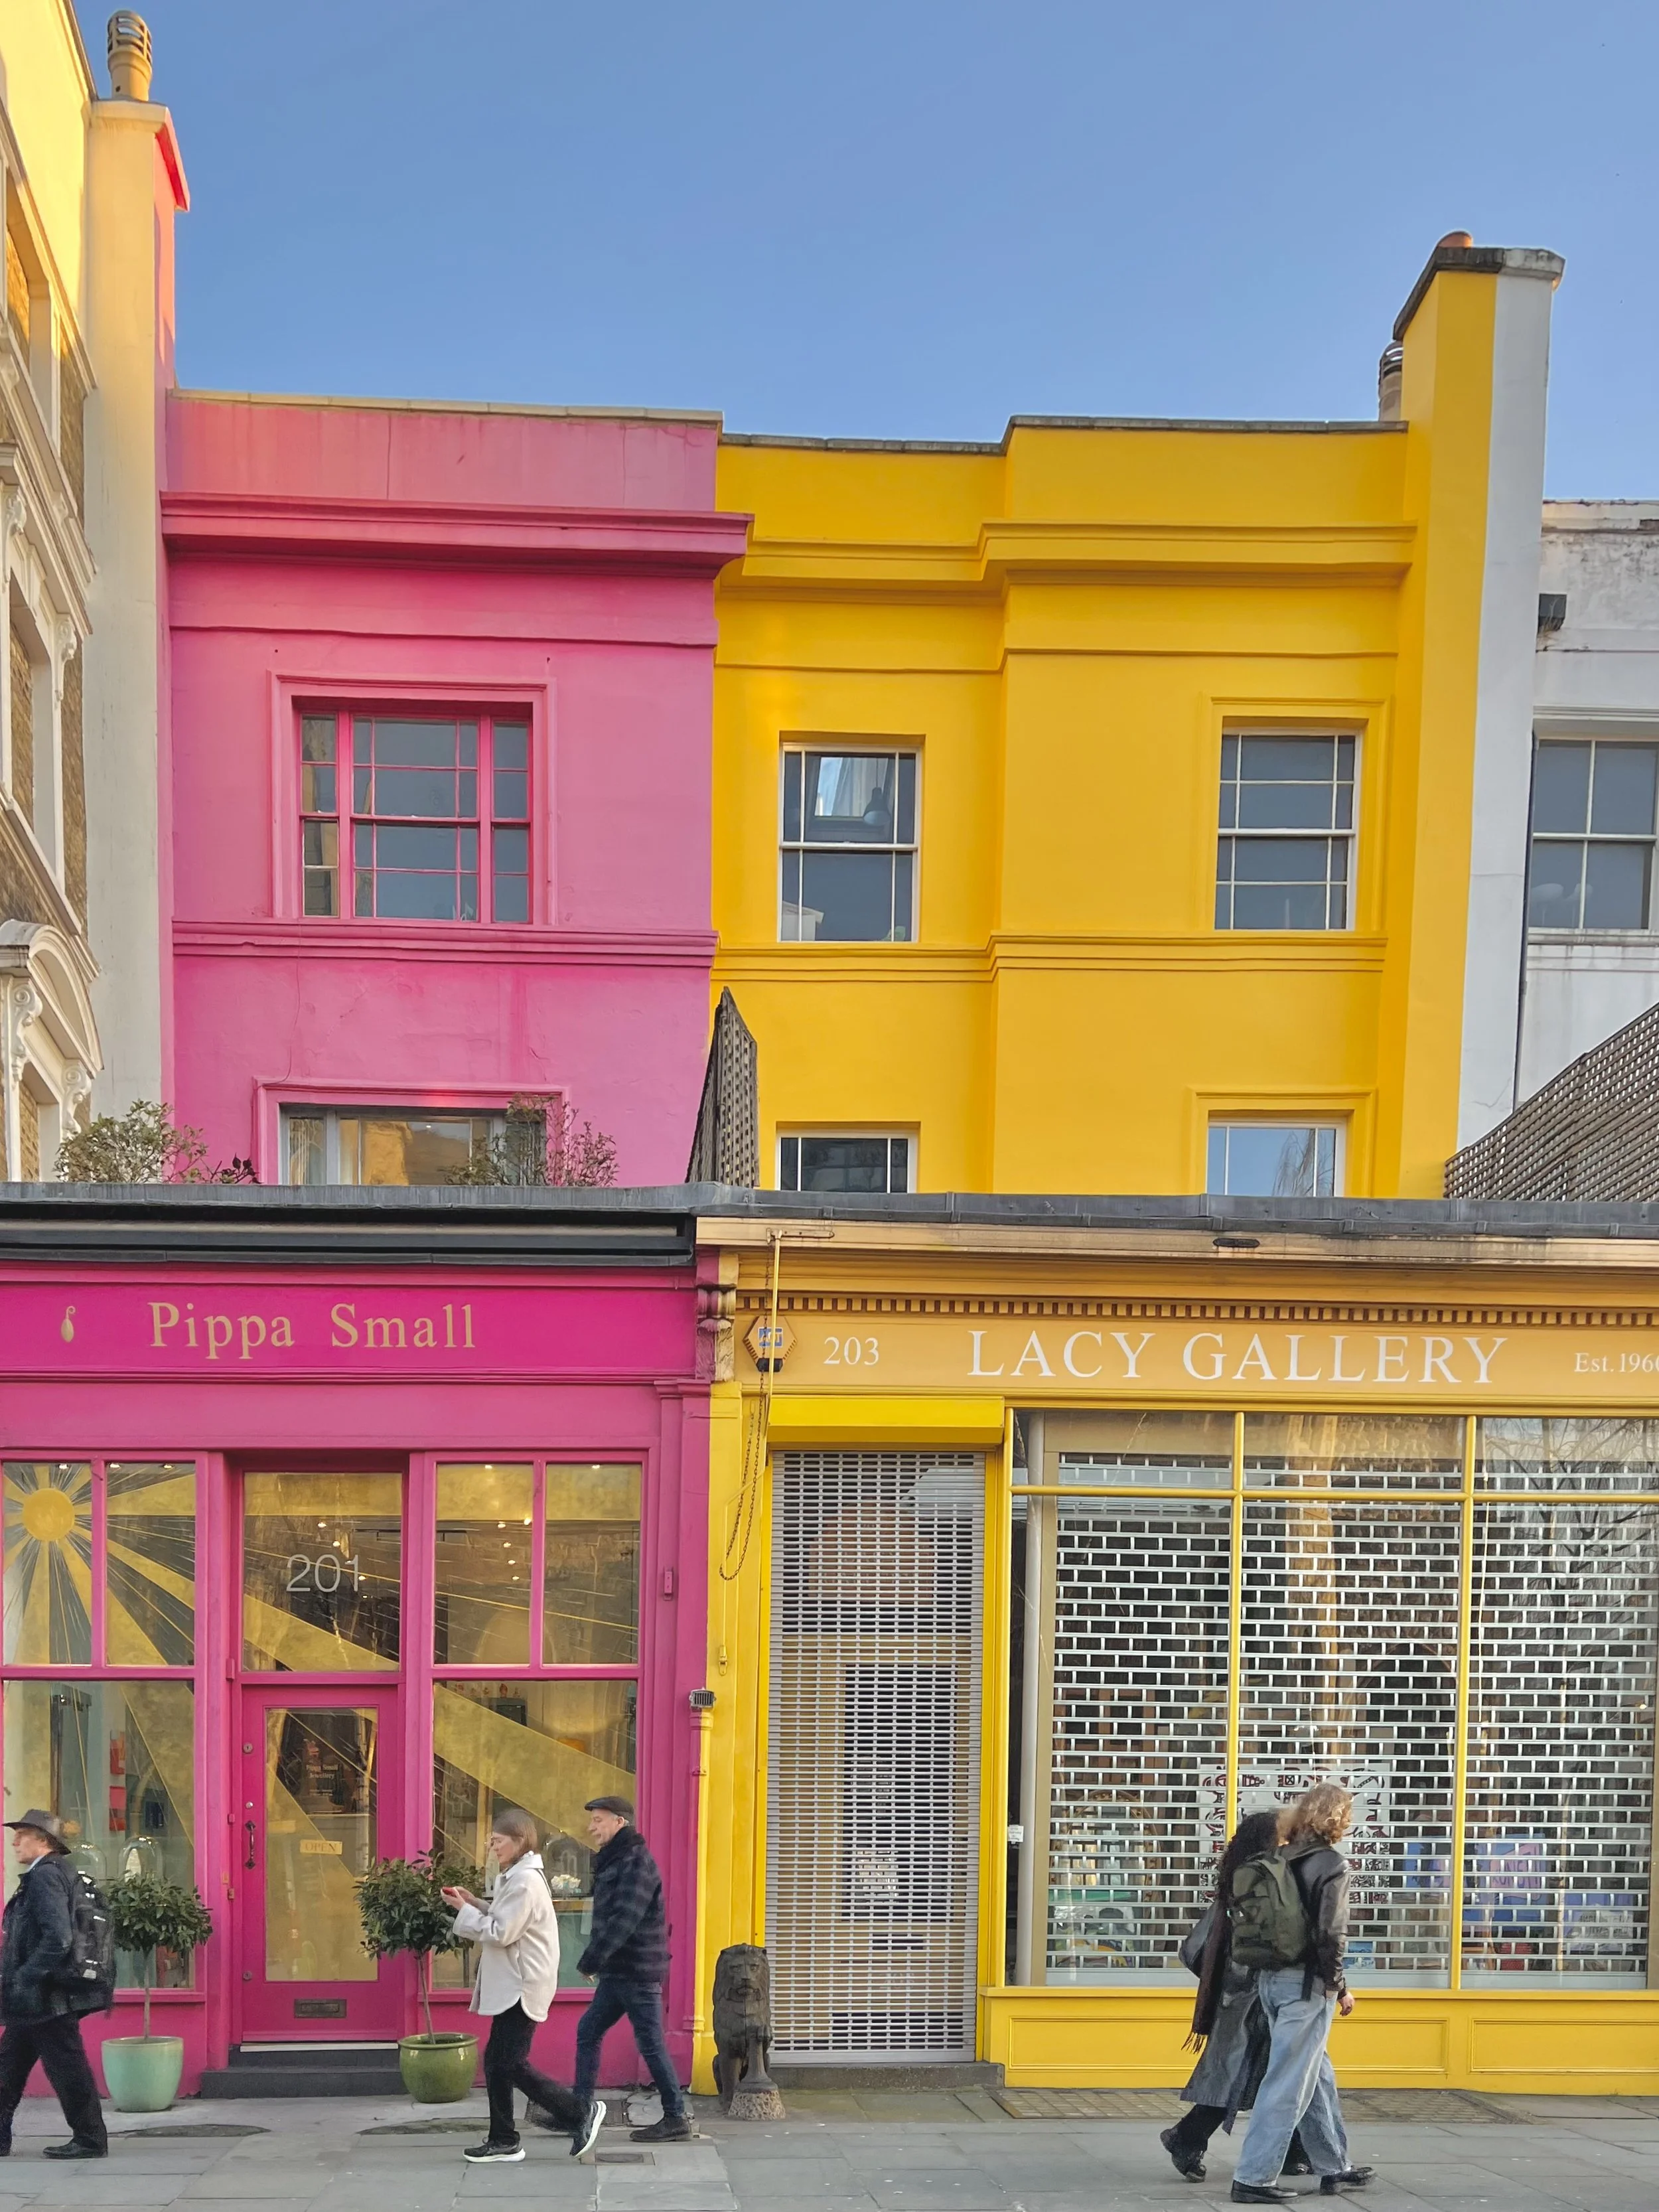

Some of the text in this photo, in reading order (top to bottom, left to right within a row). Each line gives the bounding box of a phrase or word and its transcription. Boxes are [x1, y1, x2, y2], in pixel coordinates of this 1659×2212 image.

[149, 1301, 475, 1360] Pippa Small
[823, 1336, 880, 1366] 203
[967, 1330, 1508, 1384] LACY GALLERY
[285, 1554, 360, 1593] 201
[305, 1842, 336, 1852] OPEN
